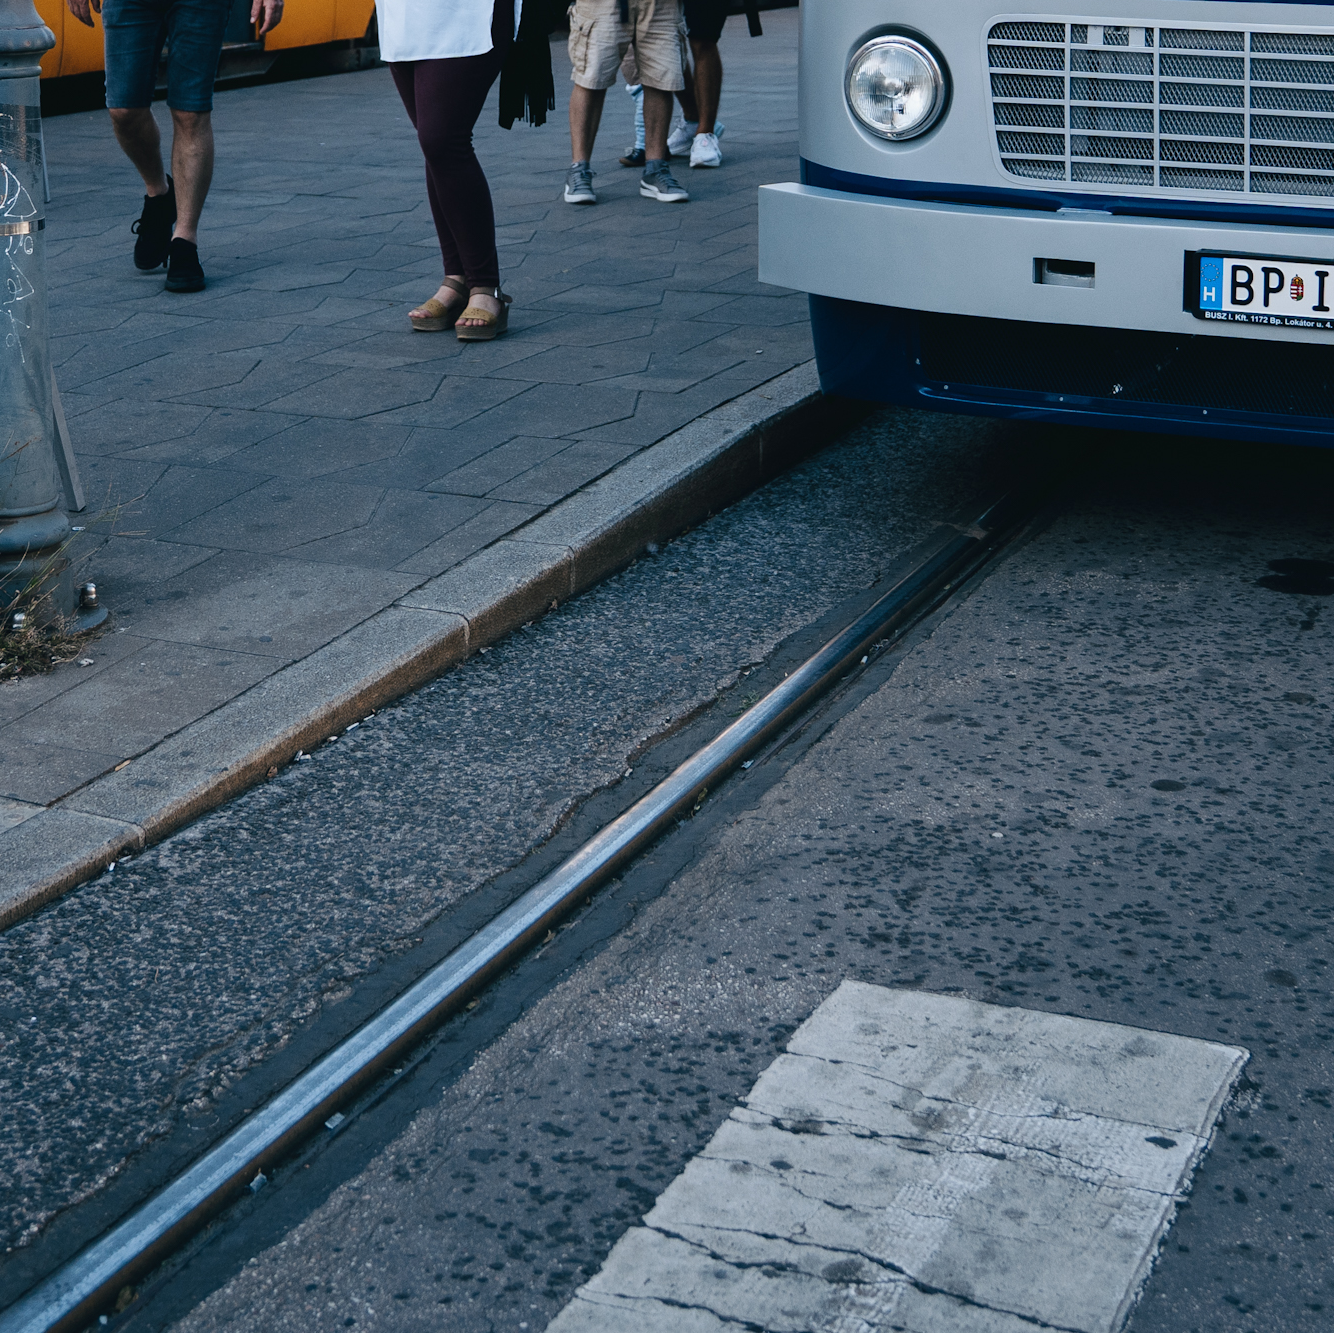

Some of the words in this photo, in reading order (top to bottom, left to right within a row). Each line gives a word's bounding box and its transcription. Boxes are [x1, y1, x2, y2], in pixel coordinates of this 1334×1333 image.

[1203, 287, 1216, 302] H
[1230, 264, 1285, 308] BP
[1204, 311, 1226, 320] BUSZ
[1235, 313, 1249, 322] Kft.
[1250, 315, 1268, 324] 1172
[1269, 317, 1283, 327] Bp.
[1284, 318, 1315, 328] Lokátor
[1325, 321, 1333, 329] 4.
